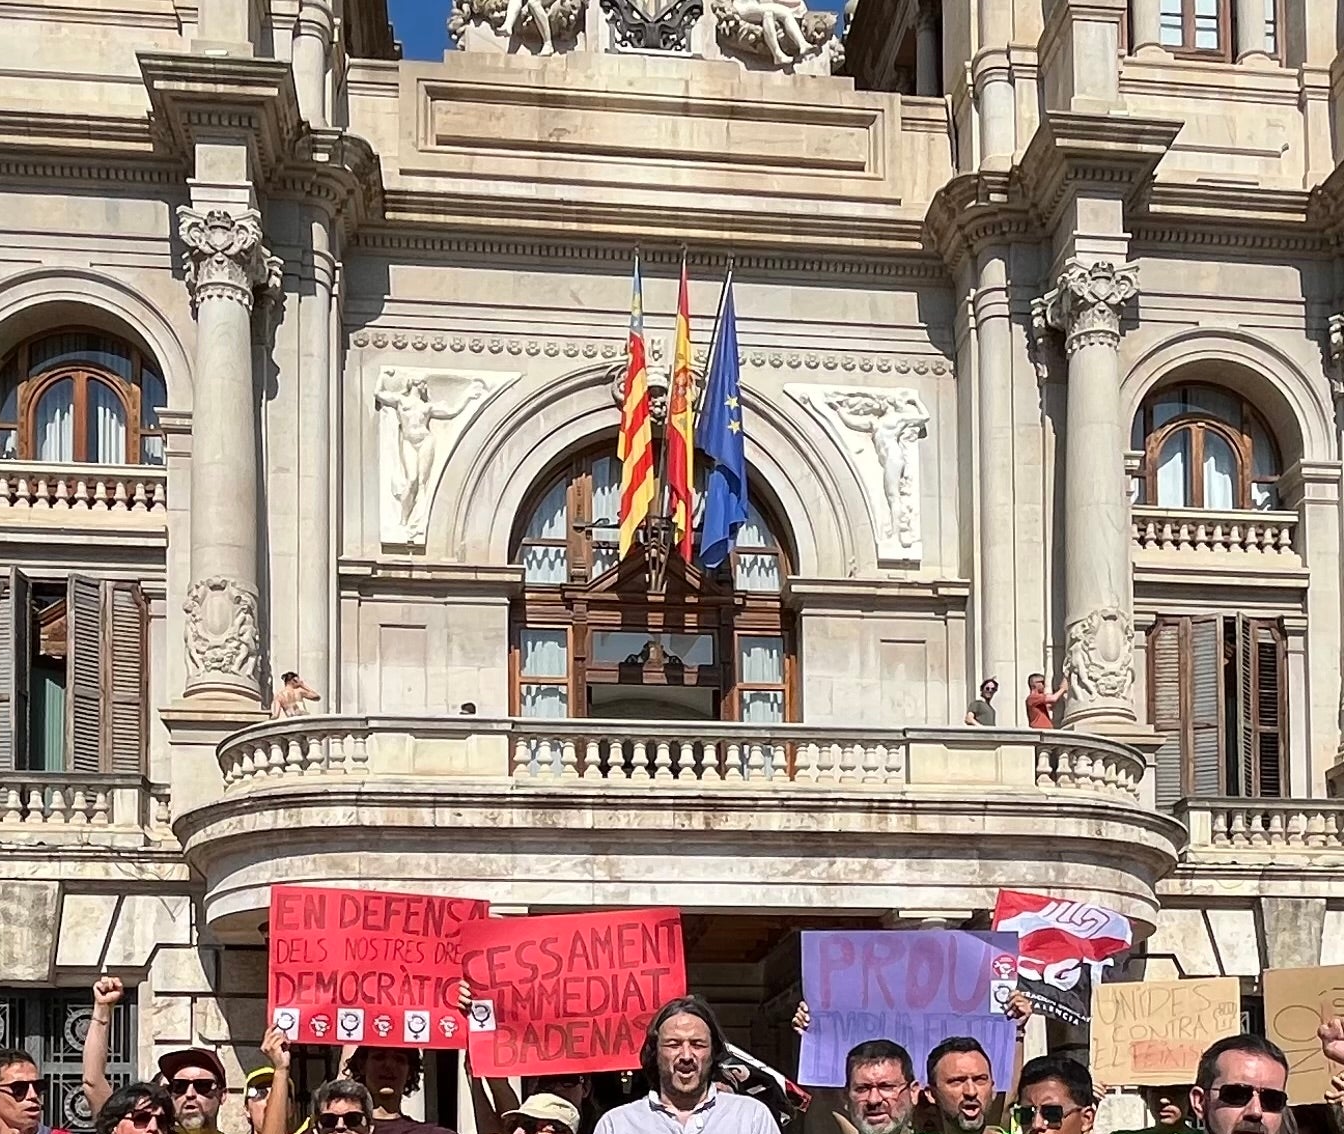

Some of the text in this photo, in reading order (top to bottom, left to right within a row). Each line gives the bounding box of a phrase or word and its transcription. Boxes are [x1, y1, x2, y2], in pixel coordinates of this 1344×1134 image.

[275, 892, 486, 939] EN DEFENSA
[276, 937, 463, 966] DELS NOSTRES DRE
[461, 917, 681, 992] CESSAMENT
[818, 934, 992, 1015] PROU
[274, 964, 465, 1011] DEMOCRÀTIC
[497, 967, 671, 1024] IMMEDIAT
[1096, 983, 1212, 1025] UNIDES
[1033, 1000, 1080, 1026] ALENCIA
[1112, 1014, 1209, 1043] CONTRA
[1092, 1037, 1205, 1070] EL FEIXIS
[1273, 1004, 1325, 1075] NO
